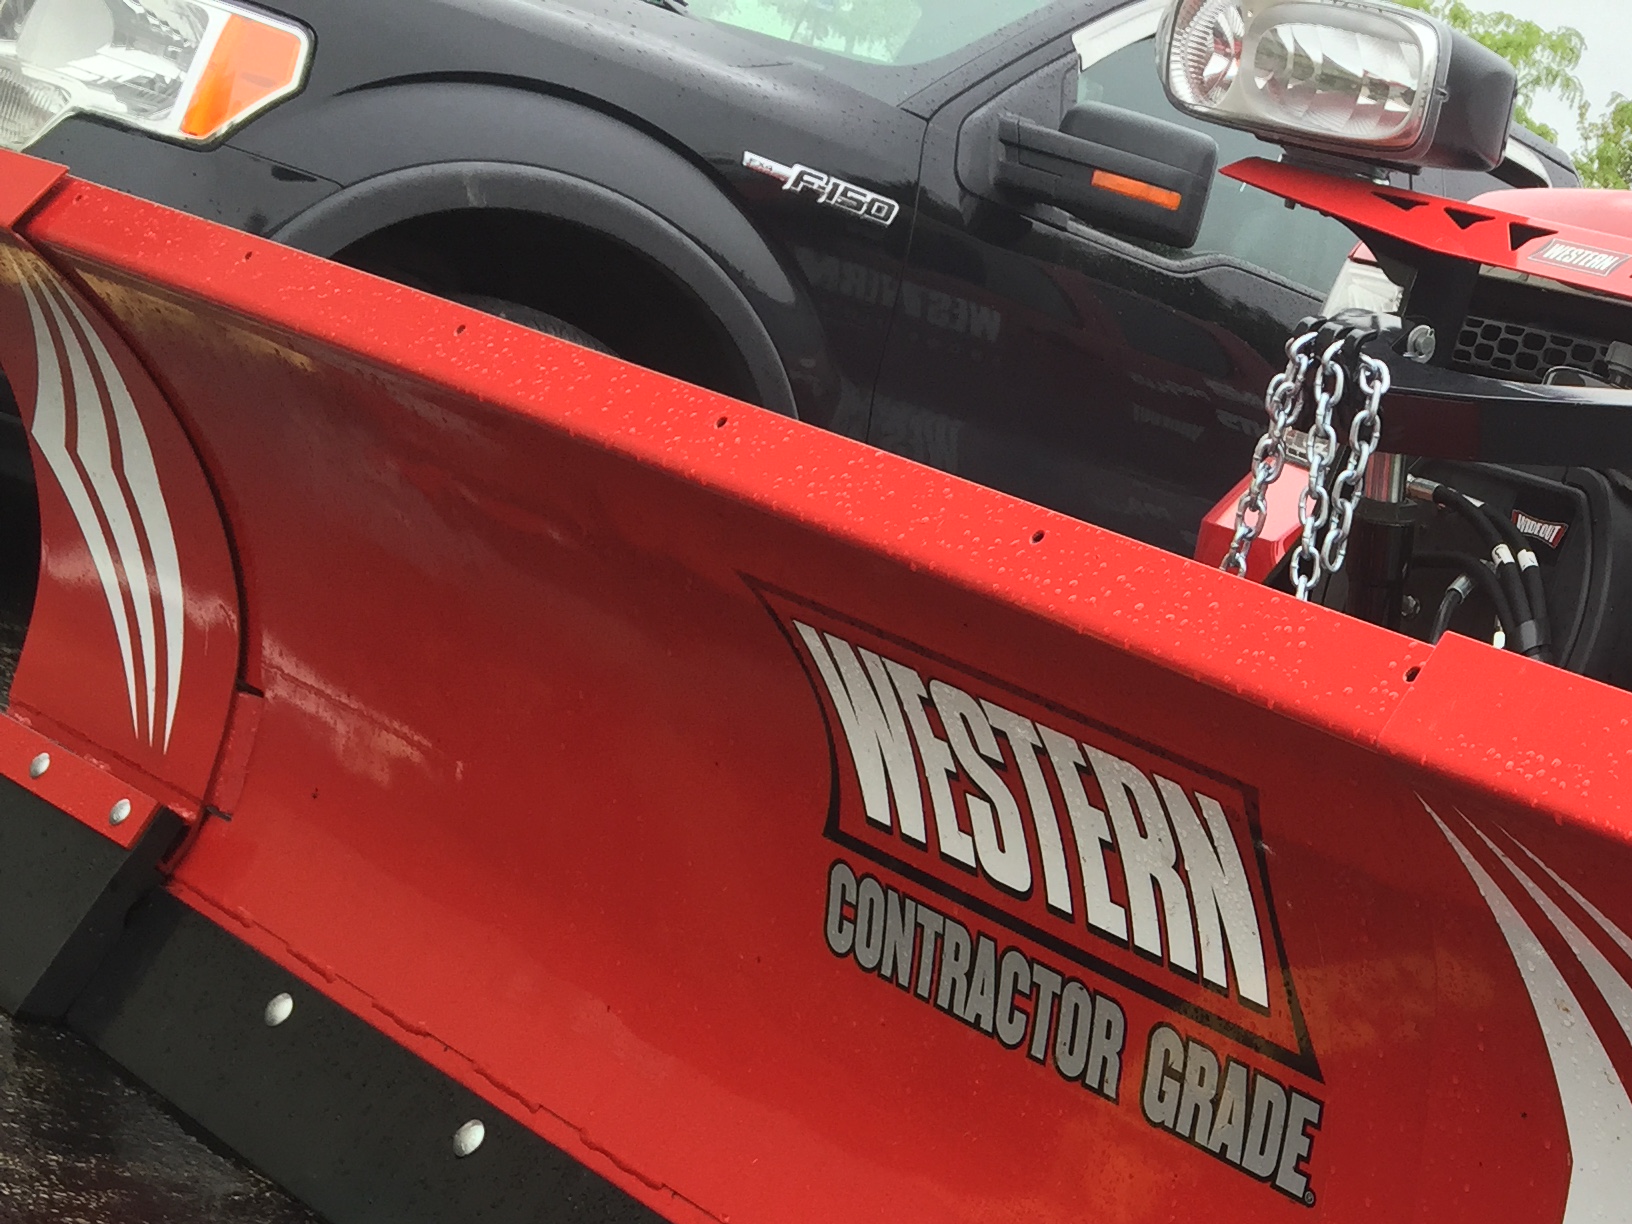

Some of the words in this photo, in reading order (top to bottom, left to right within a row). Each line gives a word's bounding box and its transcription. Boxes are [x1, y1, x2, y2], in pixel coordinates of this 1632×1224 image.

[1542, 243, 1620, 271] WESTERN
[791, 617, 1271, 1012] WESTERN
[824, 858, 1126, 1105] CONTRACTOR
[1139, 1020, 1324, 1202] GRADE
